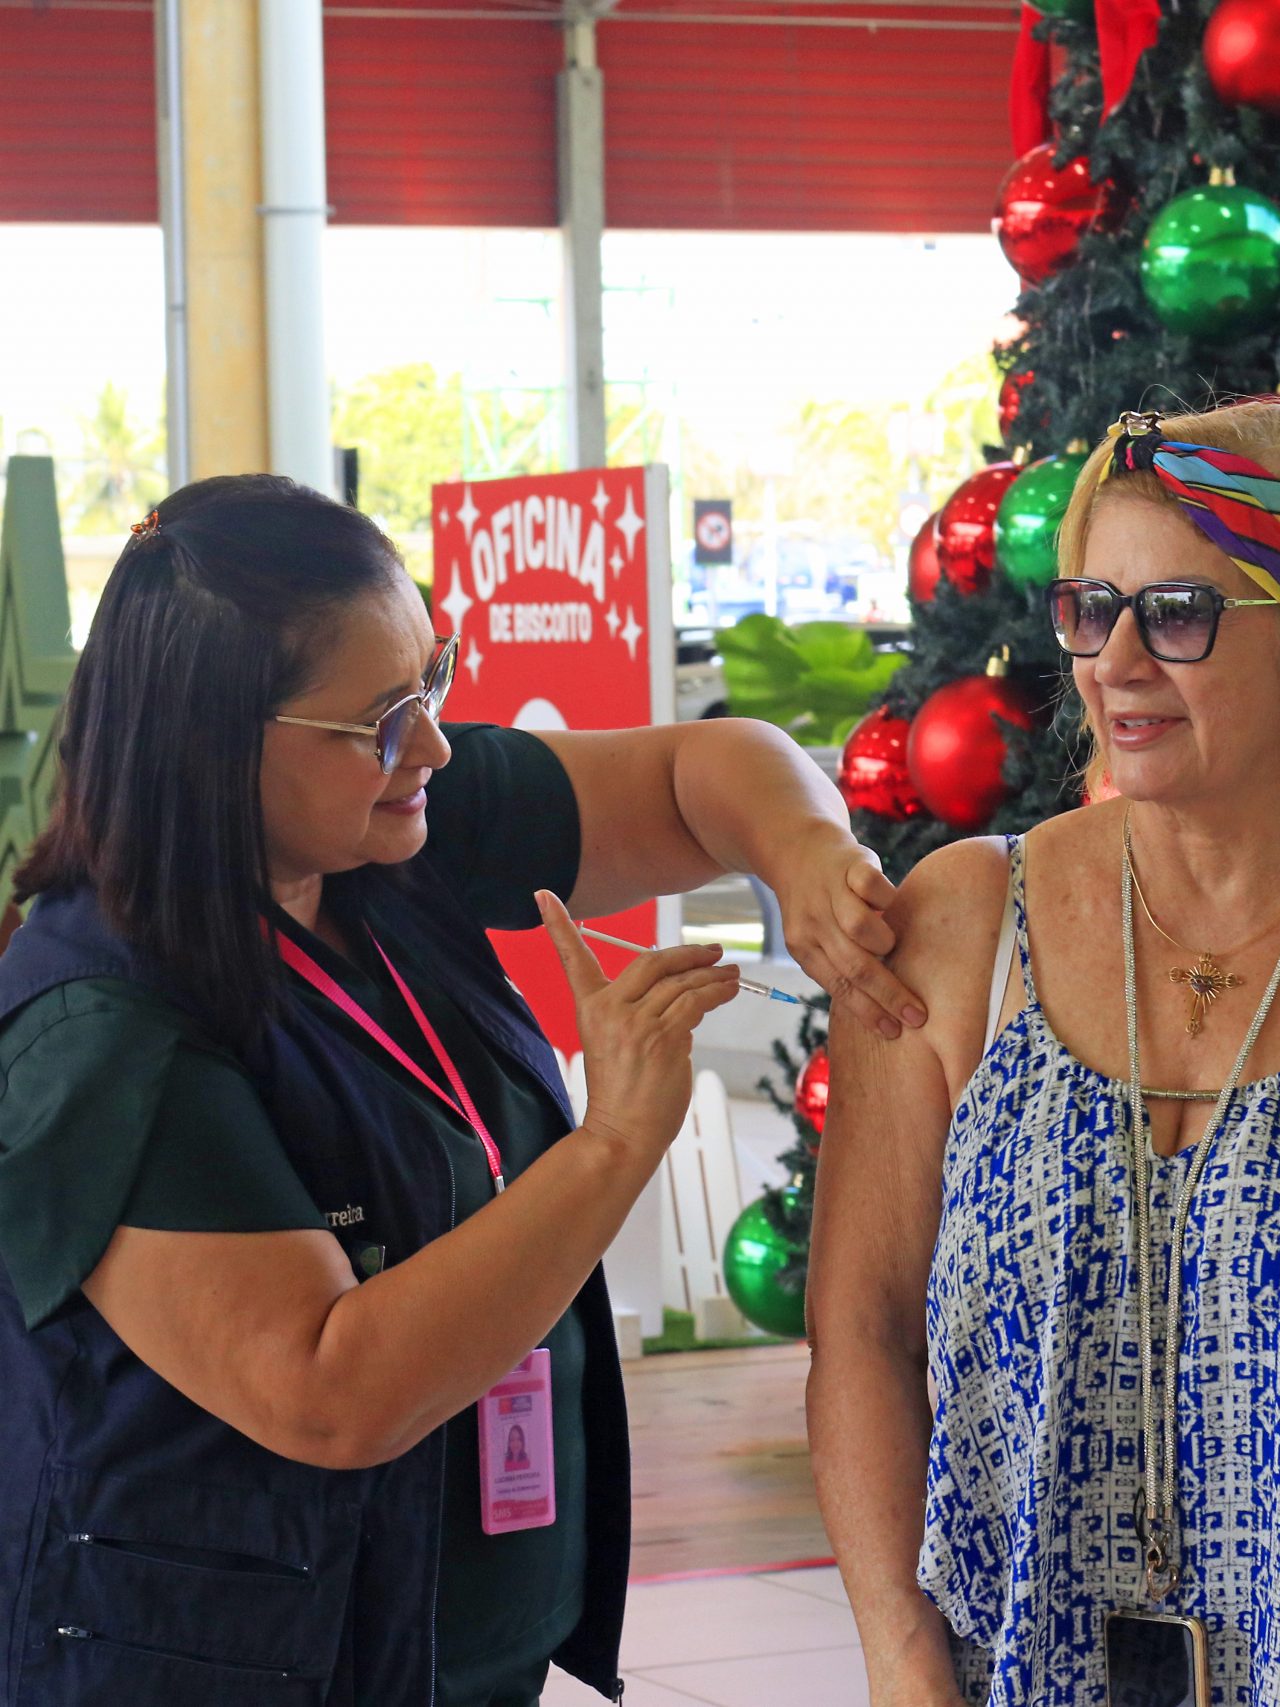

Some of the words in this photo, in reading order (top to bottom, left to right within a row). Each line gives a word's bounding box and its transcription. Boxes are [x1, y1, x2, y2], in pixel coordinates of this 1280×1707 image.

[471, 495, 605, 603] OFICINA
[489, 603, 513, 643] DE
[514, 602, 593, 643] BISCOITO
